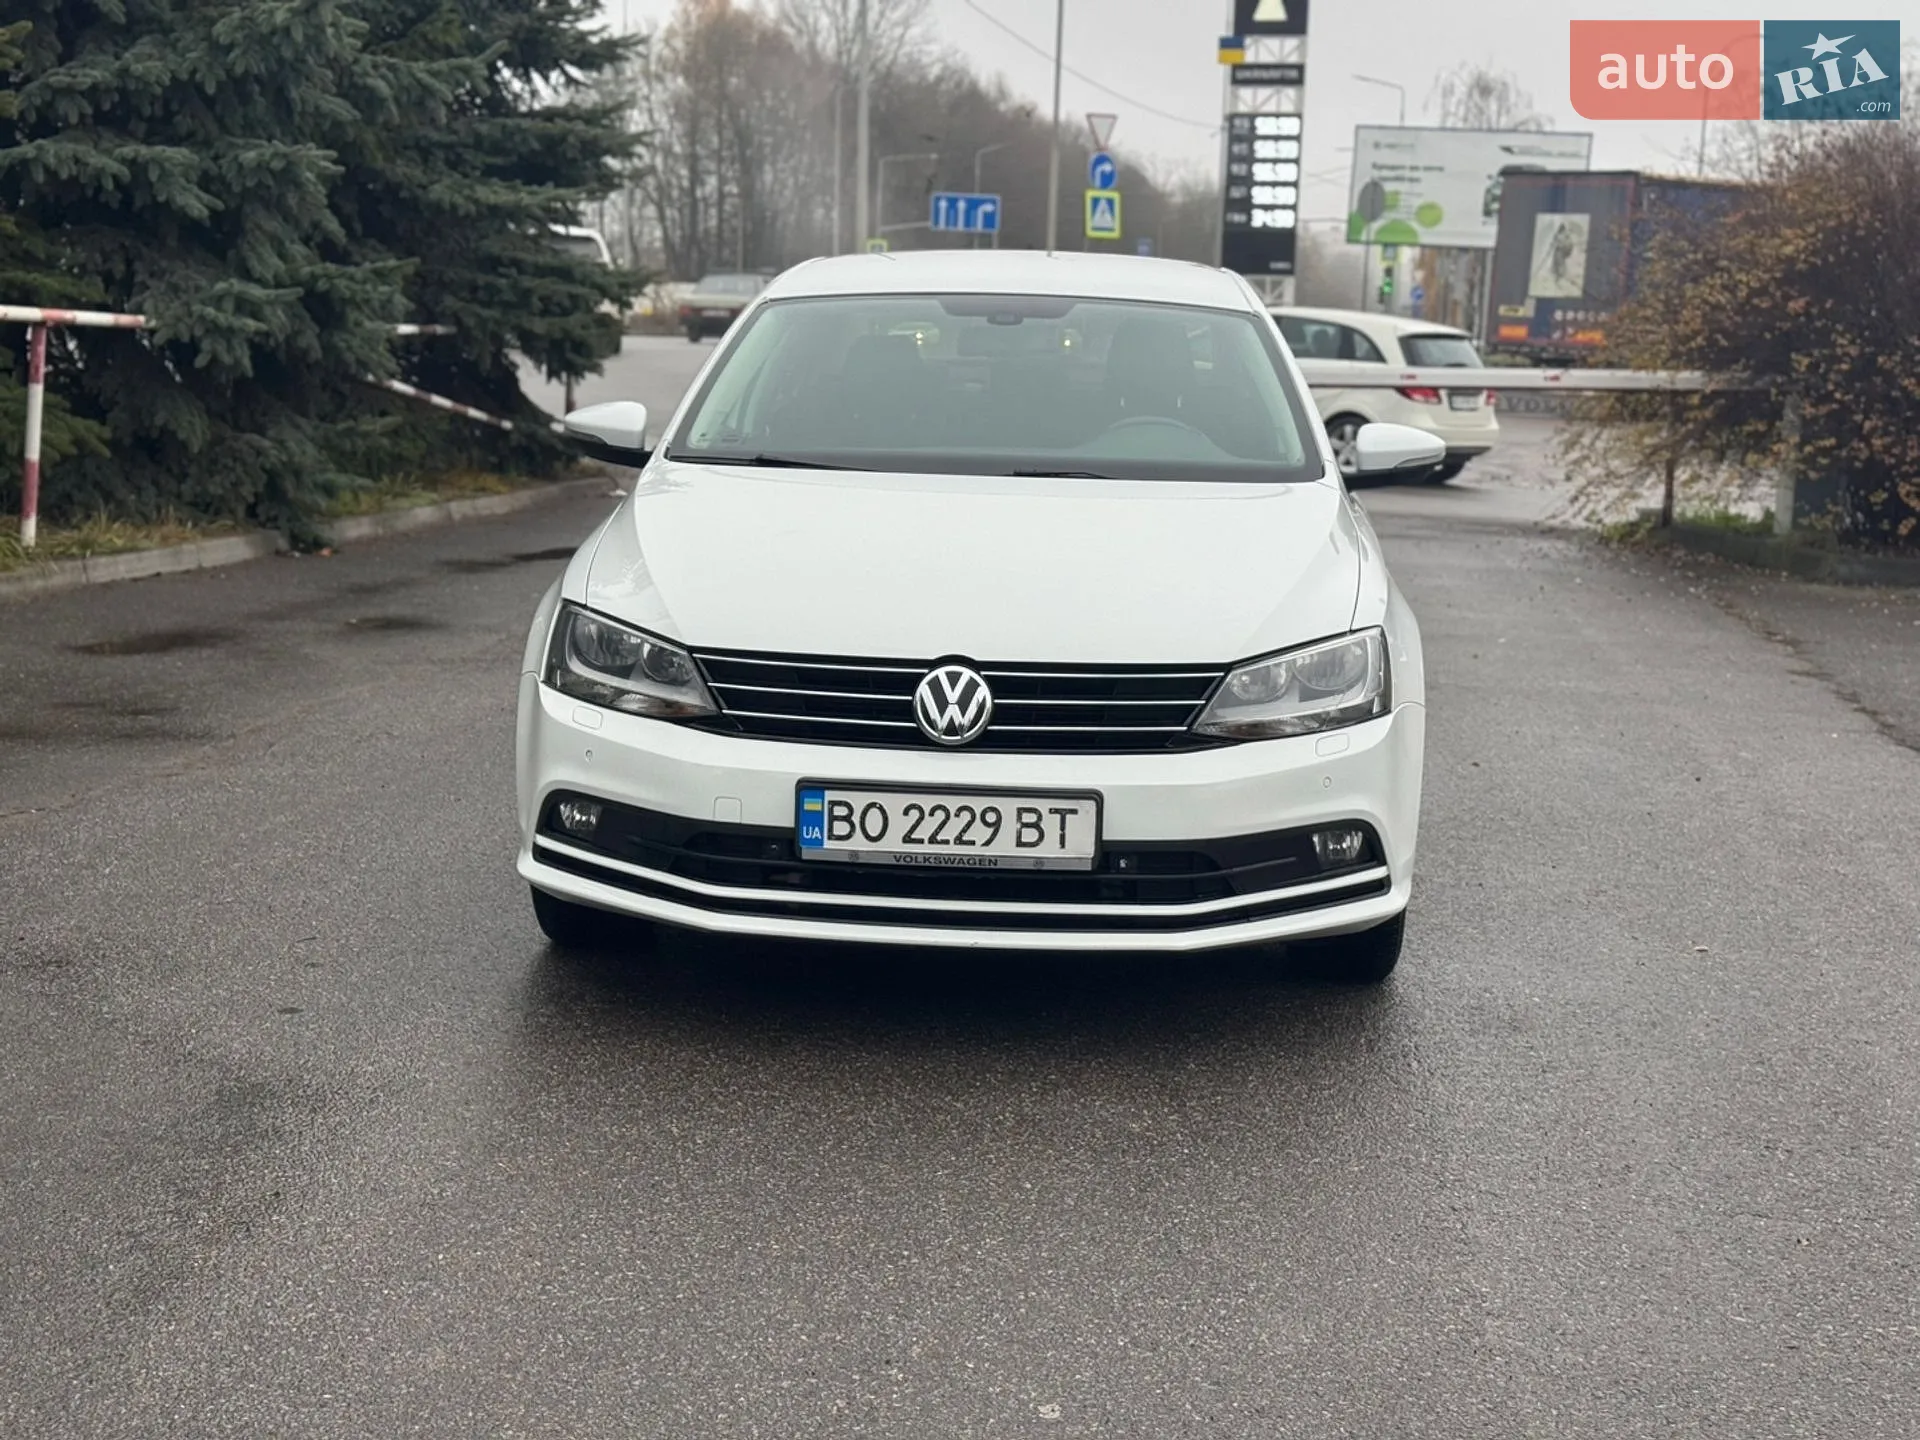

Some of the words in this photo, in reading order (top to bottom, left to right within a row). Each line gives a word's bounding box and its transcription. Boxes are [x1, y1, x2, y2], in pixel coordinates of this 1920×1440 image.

[827, 799, 889, 843] BO
[902, 803, 1003, 847] 2229
[1015, 807, 1079, 849] BT
[803, 826, 822, 839] UA
[893, 855, 999, 868] VOLKSWAGEN
